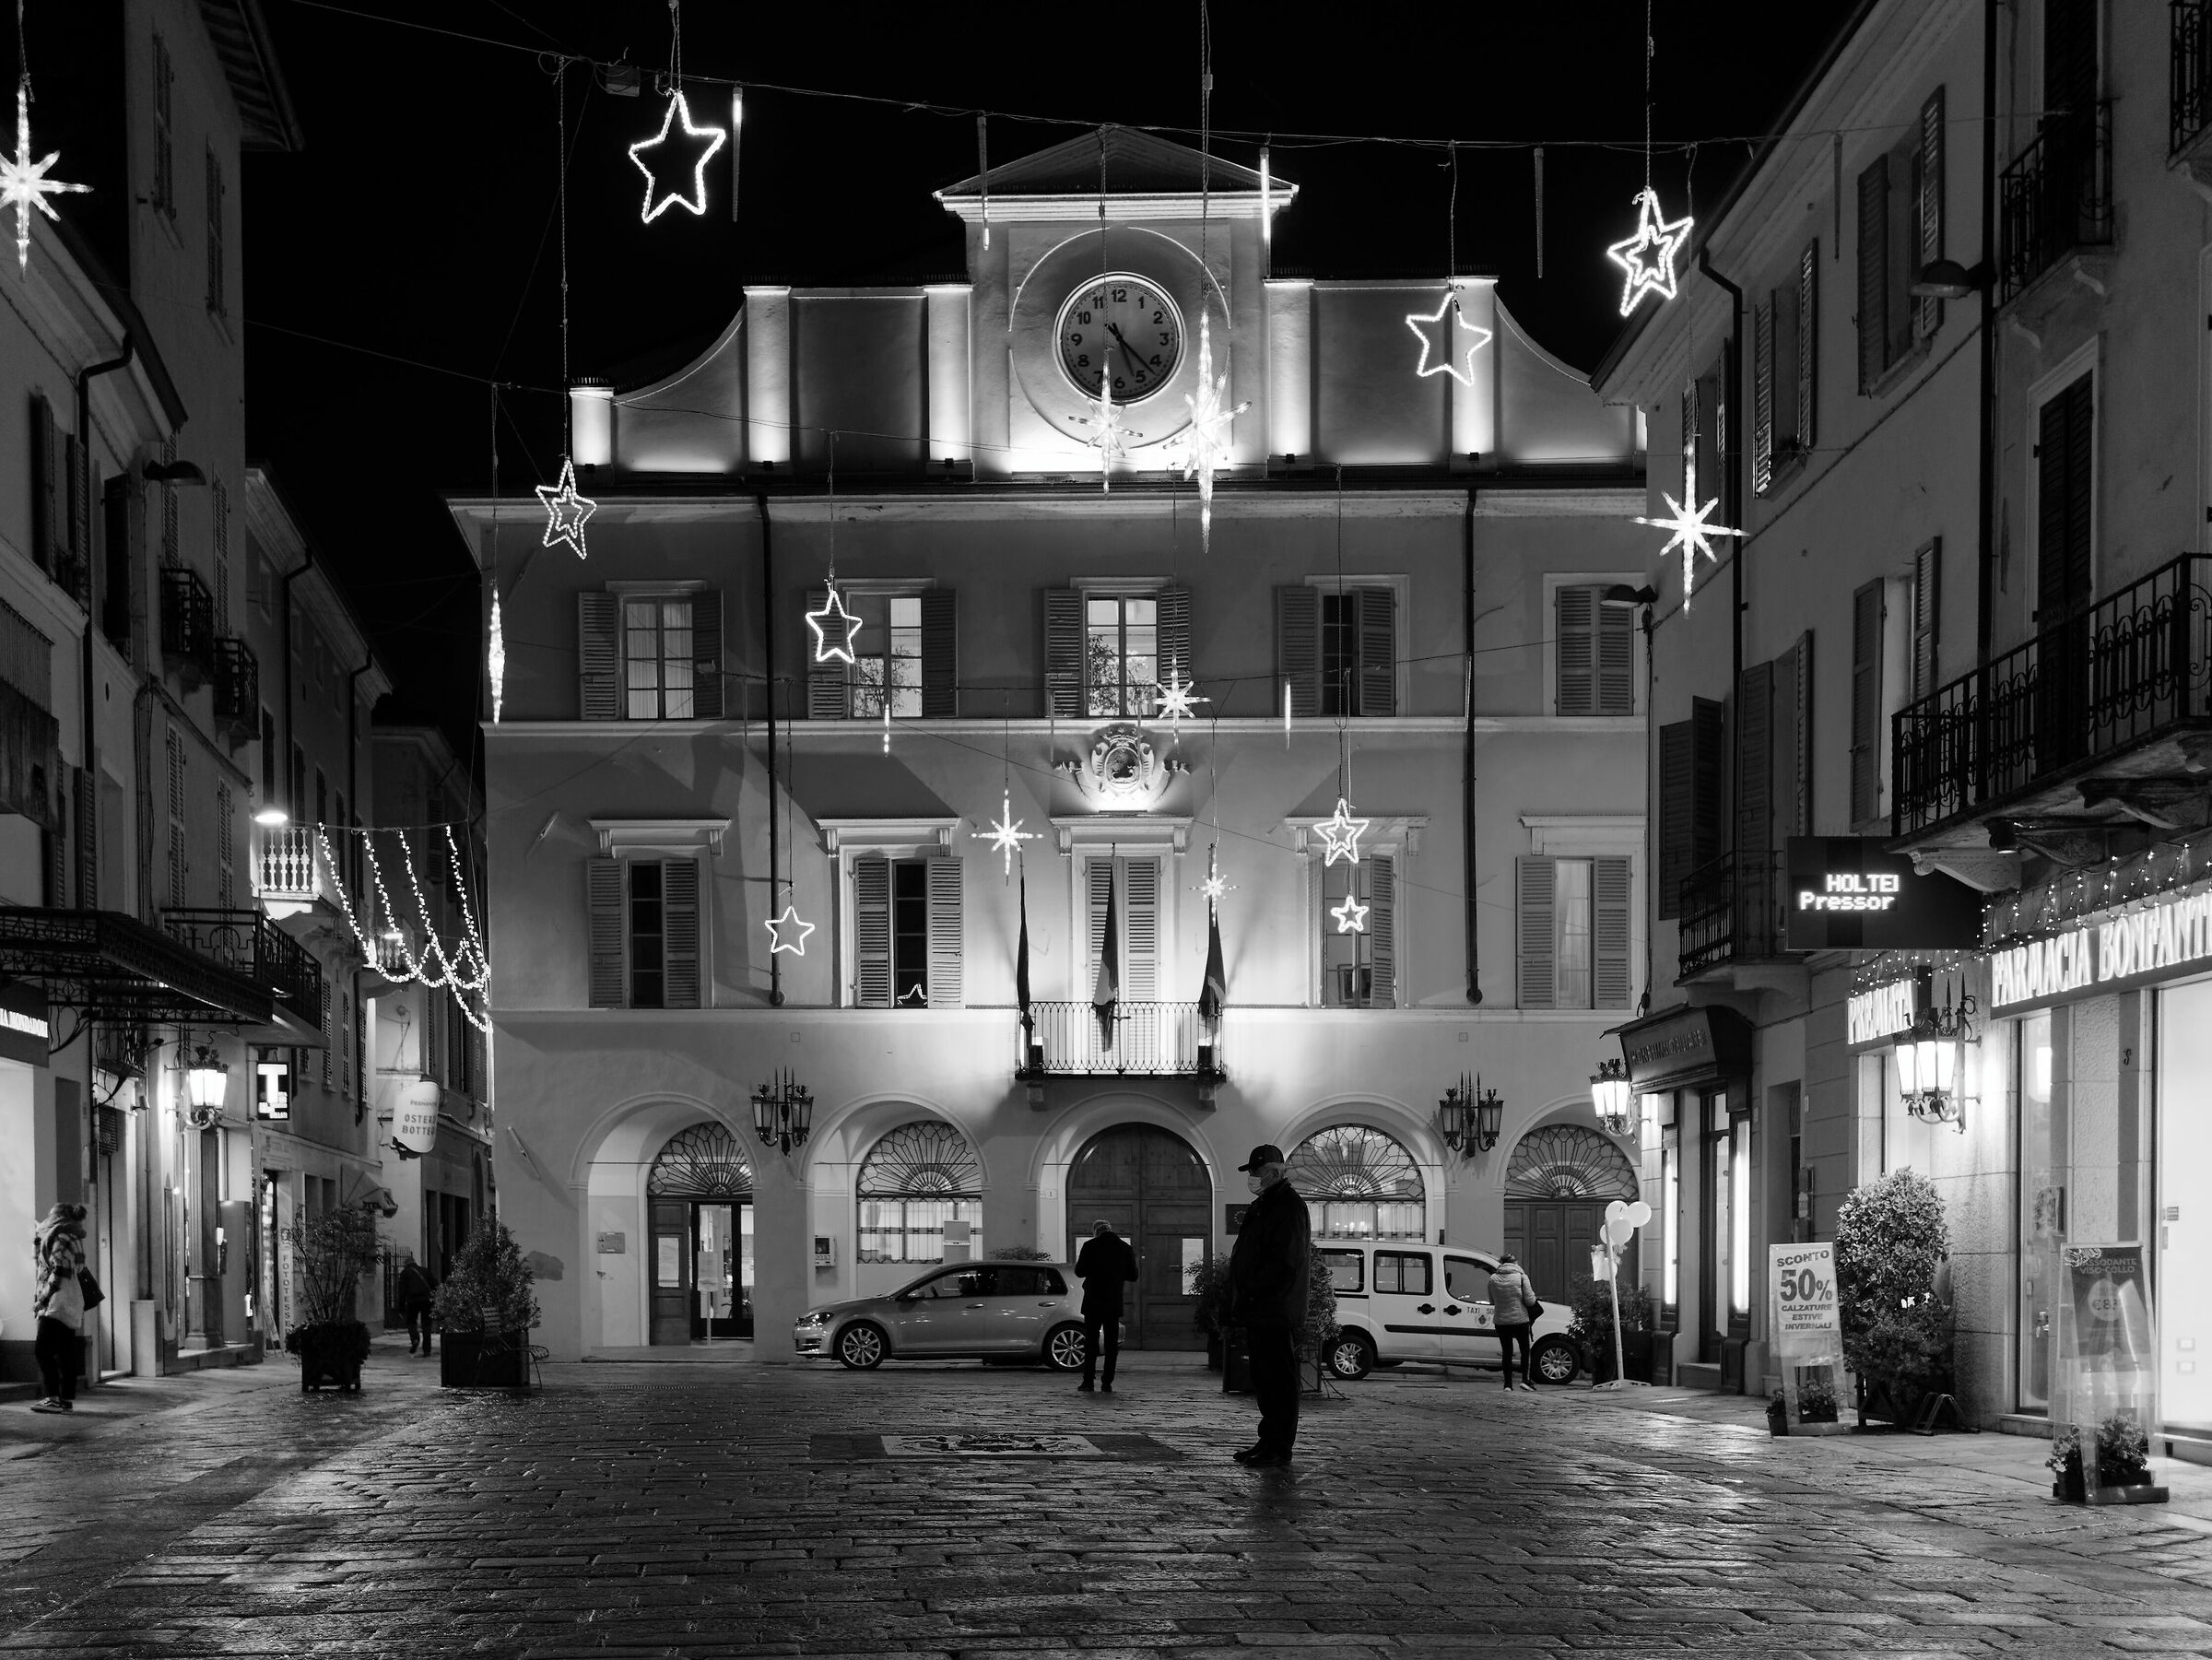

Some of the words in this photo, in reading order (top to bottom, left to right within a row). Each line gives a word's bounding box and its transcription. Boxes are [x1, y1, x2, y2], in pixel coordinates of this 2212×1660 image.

[1111, 288, 1127, 303] 12
[1092, 296, 1104, 310] 11
[1138, 296, 1146, 310] 1
[1077, 311, 1091, 325] 10
[1153, 311, 1163, 324] 2
[1070, 333, 1083, 347] 9
[1159, 332, 1170, 347] 3
[1077, 354, 1090, 368] 8
[1149, 354, 1162, 367] 4
[1093, 371, 1104, 384] 7
[1114, 376, 1125, 389] 6
[1135, 370, 1147, 383] 5
[1799, 891, 1895, 911] Pressor
[1991, 927, 2092, 1008] FARMACIA
[1847, 979, 1914, 1045] PREMIATA
[1776, 1250, 1830, 1267] SCONTO
[2078, 1257, 2137, 1266] ASSODANTE
[2079, 1266, 2136, 1275] VISO-COLLO
[1780, 1268, 1833, 1301] 50%
[1466, 1306, 1480, 1314] TAXI
[1782, 1303, 1832, 1313] CALZATURE
[1784, 1322, 1832, 1331] INVERNALI
